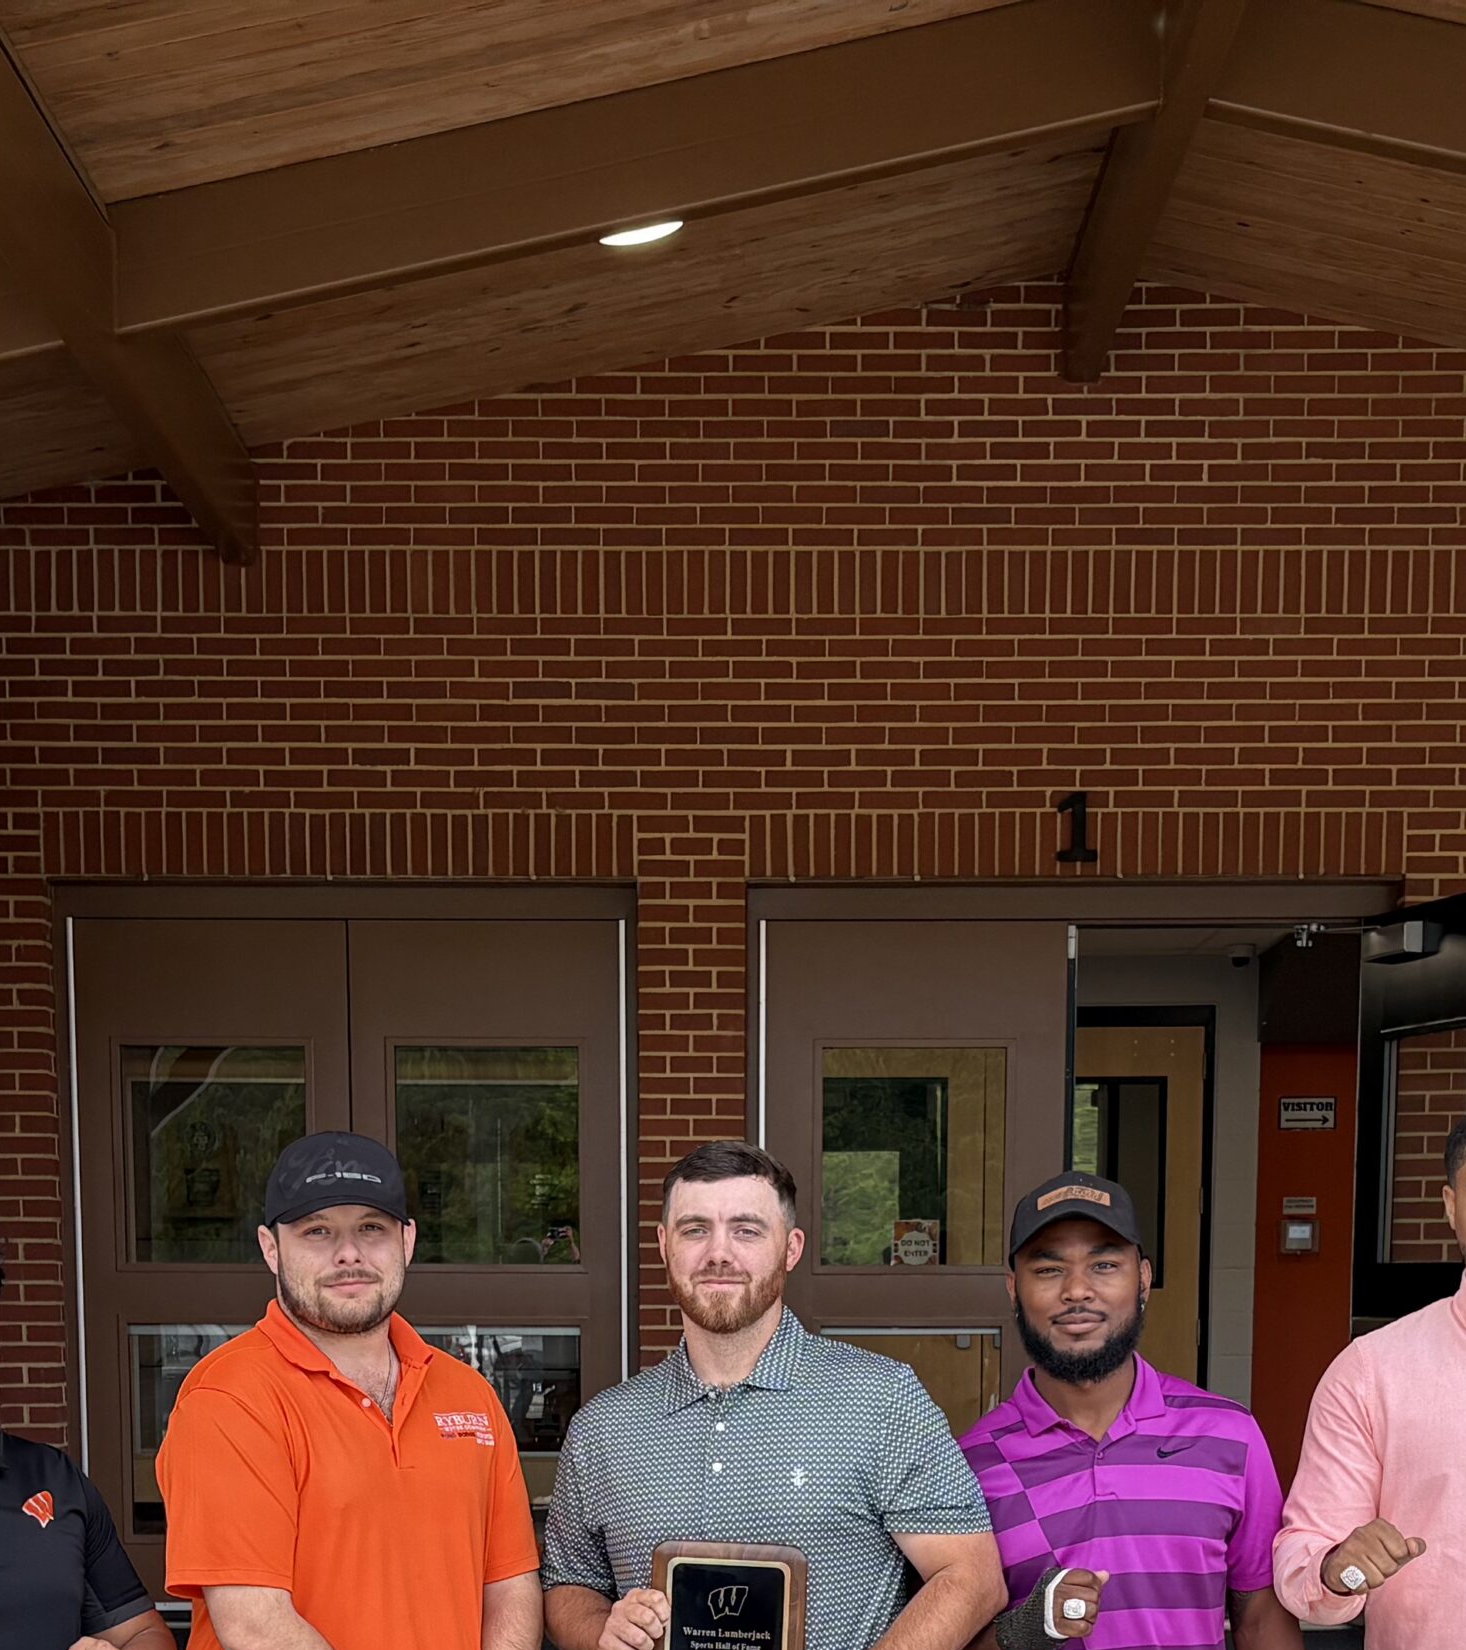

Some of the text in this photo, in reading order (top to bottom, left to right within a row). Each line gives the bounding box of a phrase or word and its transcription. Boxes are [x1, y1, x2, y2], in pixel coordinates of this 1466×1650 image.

[1056, 791, 1098, 862] 1
[1283, 1102, 1333, 1112] VISITOR
[434, 1415, 489, 1427] RYBURN
[683, 1627, 771, 1641] Warren Lumberjack
[690, 1640, 714, 1650] Sports
[715, 1642, 731, 1650] Hall
[732, 1643, 740, 1650] of
